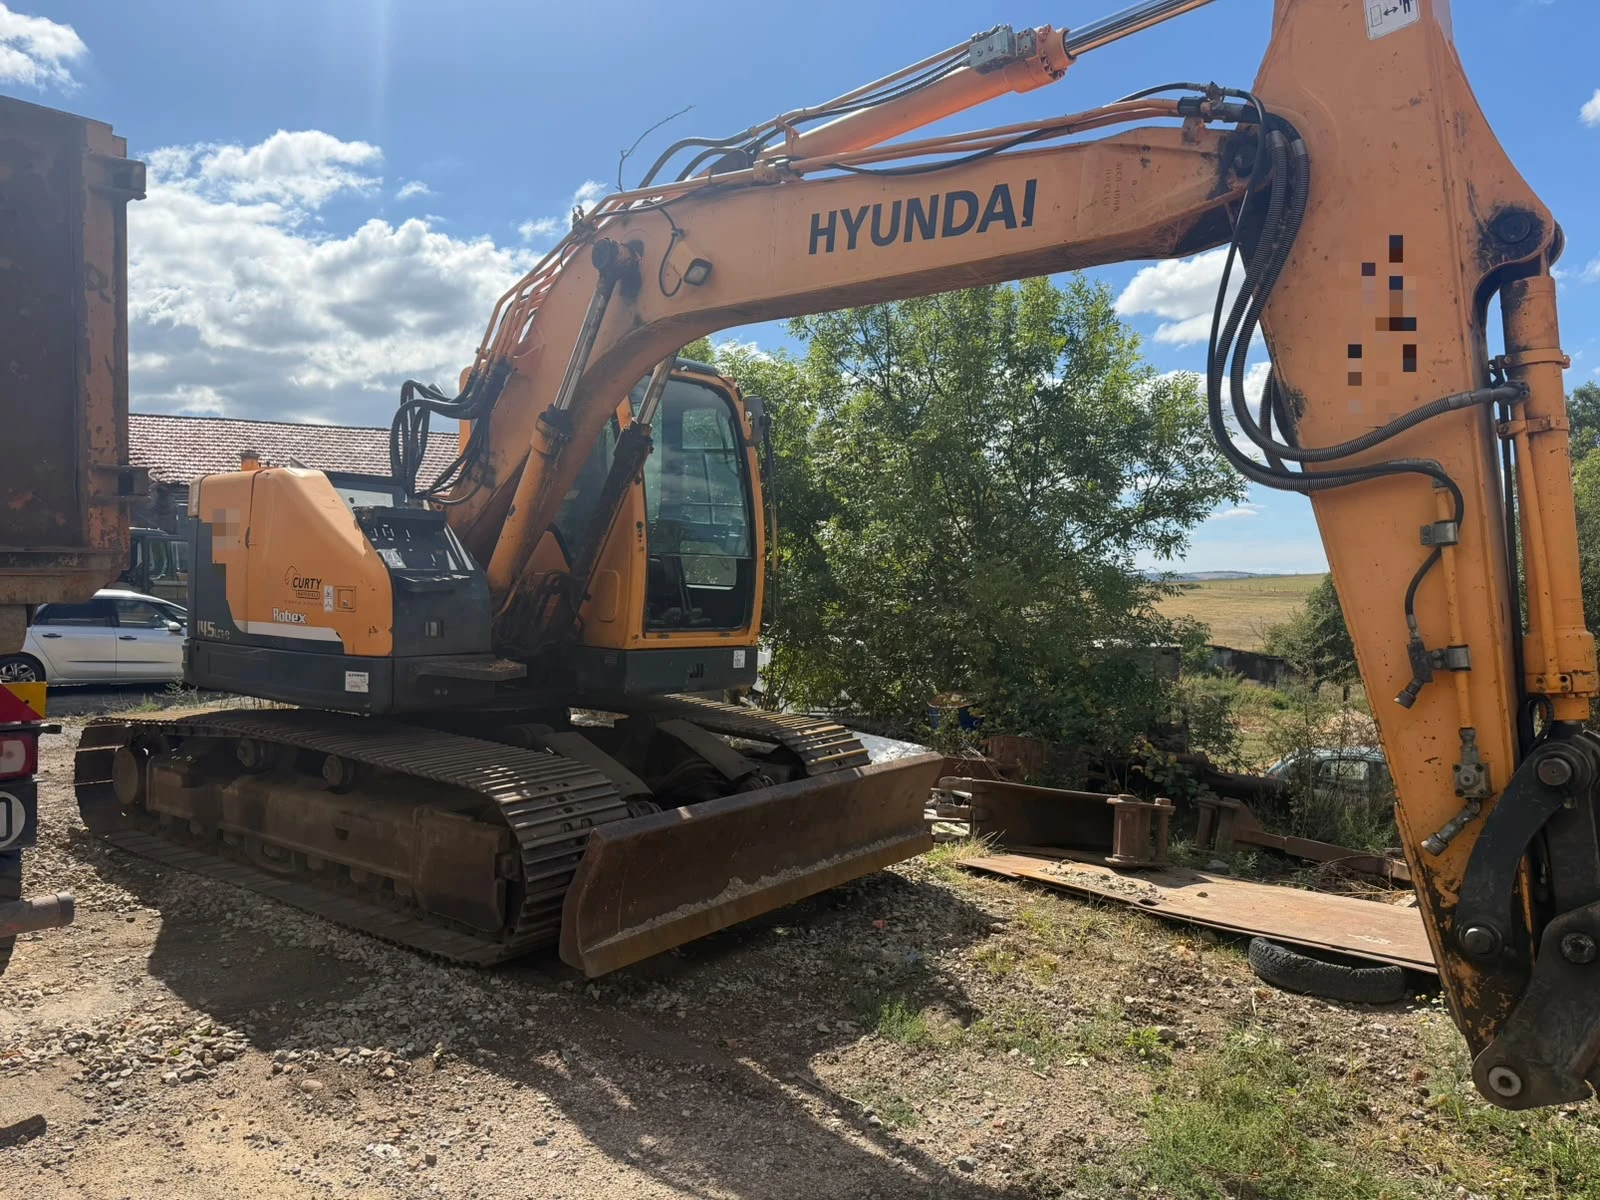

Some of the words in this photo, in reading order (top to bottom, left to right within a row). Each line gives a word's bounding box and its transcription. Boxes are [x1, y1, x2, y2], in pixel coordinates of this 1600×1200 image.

[808, 178, 1037, 255] HYUNDAI
[292, 577, 322, 590] CURTY
[272, 607, 307, 624] Robex
